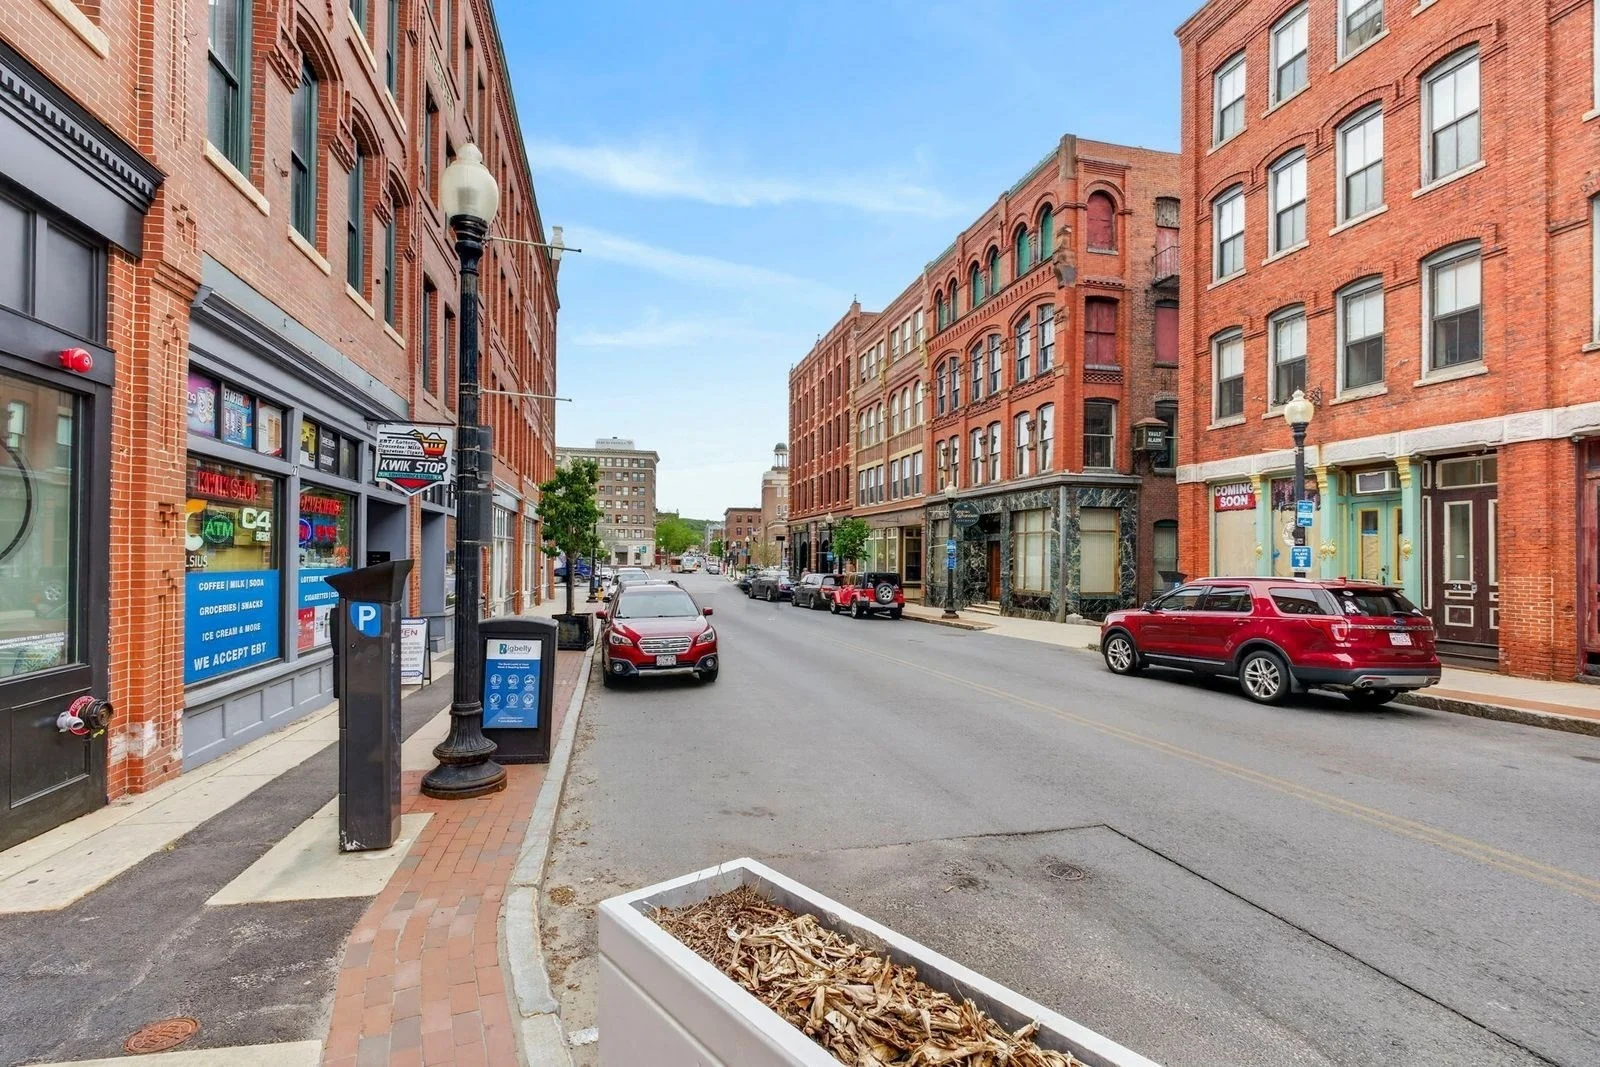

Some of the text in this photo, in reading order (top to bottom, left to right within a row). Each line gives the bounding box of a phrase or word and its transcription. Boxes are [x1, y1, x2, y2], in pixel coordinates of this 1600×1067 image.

[380, 459, 446, 474] KWIK STOP
[197, 471, 258, 502] KWIK STOP
[1215, 483, 1254, 497] COMING
[299, 494, 342, 516] ONVENIENCE
[1220, 494, 1249, 507] SOON
[242, 507, 271, 531] C4
[204, 520, 234, 537] ATM
[199, 578, 264, 591] COFFEE MILK SODA
[300, 575, 318, 583] LOTTERY
[304, 592, 329, 601] CIGARETTES
[199, 600, 264, 616] GROCERIES SNACKS
[358, 605, 376, 631] P
[202, 631, 214, 641] ICE
[215, 626, 238, 639] CREAM
[245, 622, 261, 633] MORE
[193, 641, 267, 671] WE ACCEPT EBT
[499, 643, 532, 655] Bigbelly
